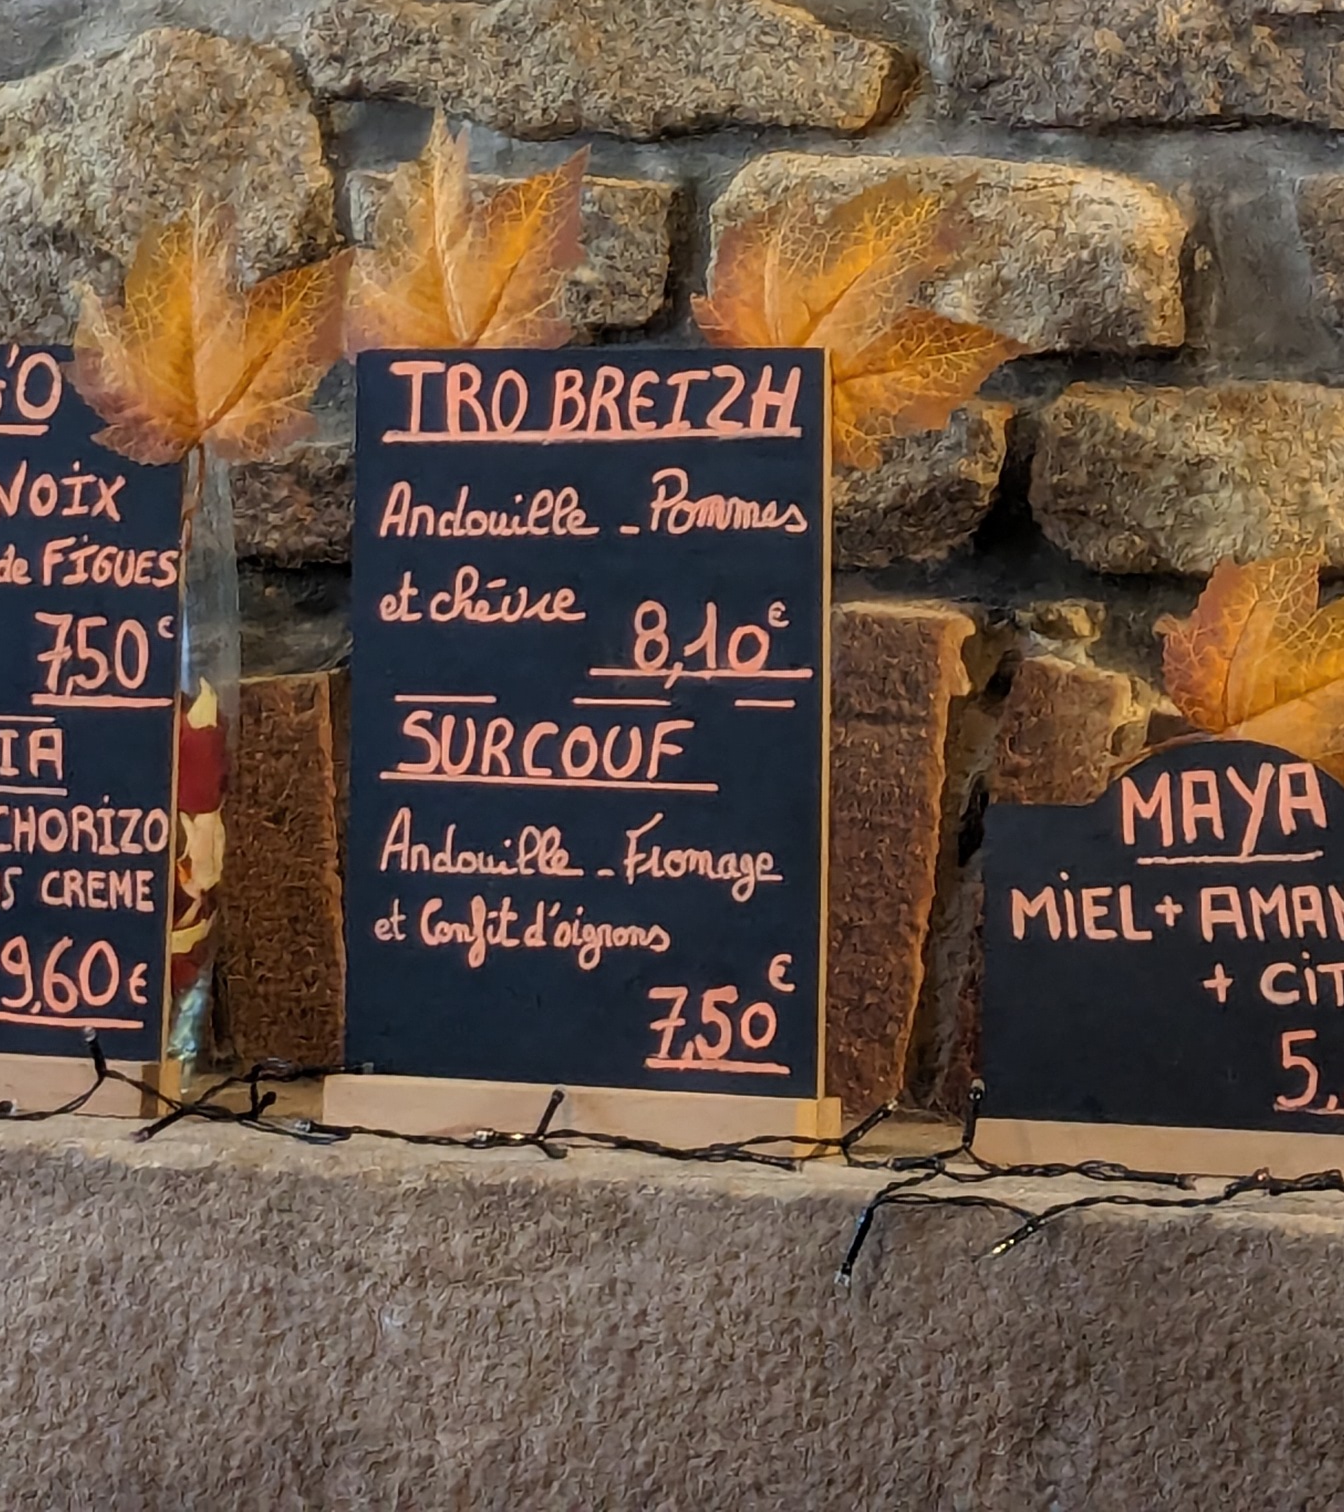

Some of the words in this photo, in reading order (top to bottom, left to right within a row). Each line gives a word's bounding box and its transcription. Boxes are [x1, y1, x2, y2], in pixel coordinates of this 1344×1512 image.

[389, 361, 529, 436] TRO
[552, 364, 802, 436] BREIZH
[378, 480, 601, 539] Andouille
[650, 467, 809, 536] Pommes
[379, 570, 423, 623] et
[396, 710, 696, 780] SURCOUF
[1119, 761, 1329, 856] MAYA
[40, 868, 156, 913] CREME
[378, 806, 585, 878] Andouille
[623, 812, 784, 903] Fromage
[373, 897, 408, 942] et
[418, 894, 520, 970] Confit
[1155, 894, 1184, 927] +
[0, 934, 149, 1014] 9,60€
[1202, 963, 1234, 1003] +
